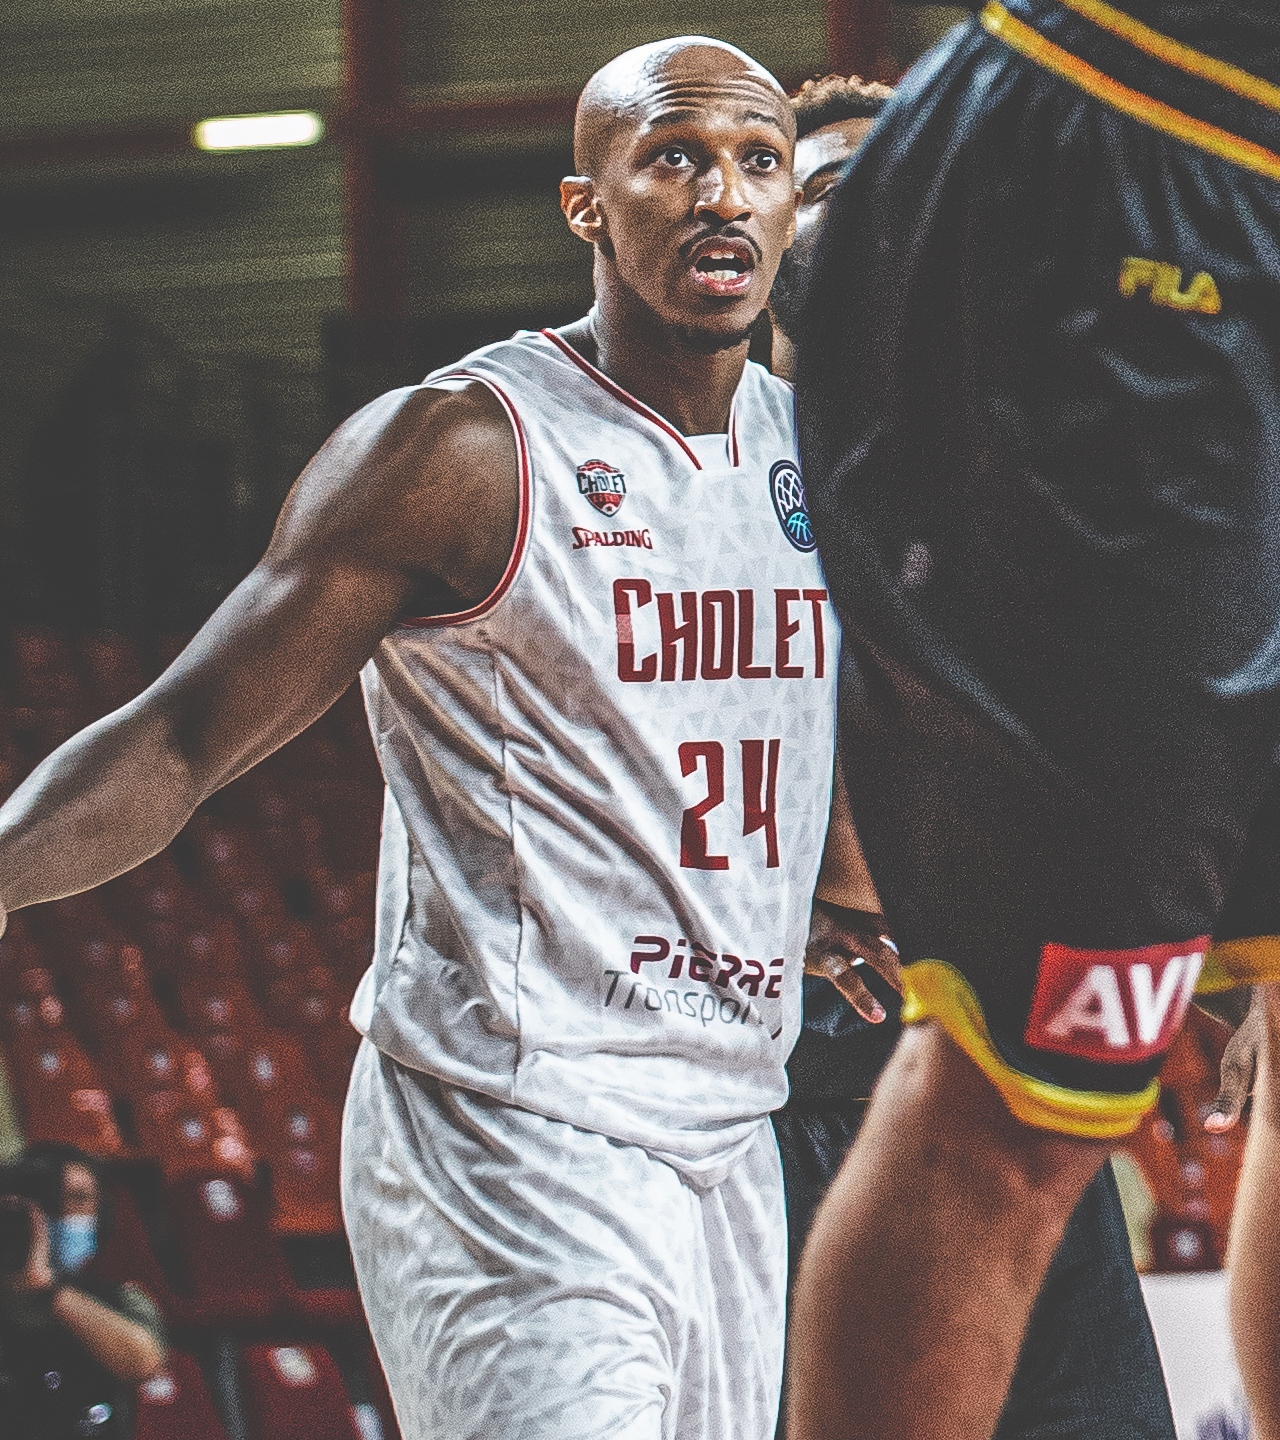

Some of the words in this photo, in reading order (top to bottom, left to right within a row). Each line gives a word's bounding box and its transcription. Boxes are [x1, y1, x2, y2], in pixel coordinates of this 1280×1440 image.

[1119, 256, 1222, 315] FILA
[576, 472, 626, 494] CHOLET
[572, 526, 653, 550] SPALDING
[612, 578, 829, 682] CHOLET
[677, 738, 781, 870] 24
